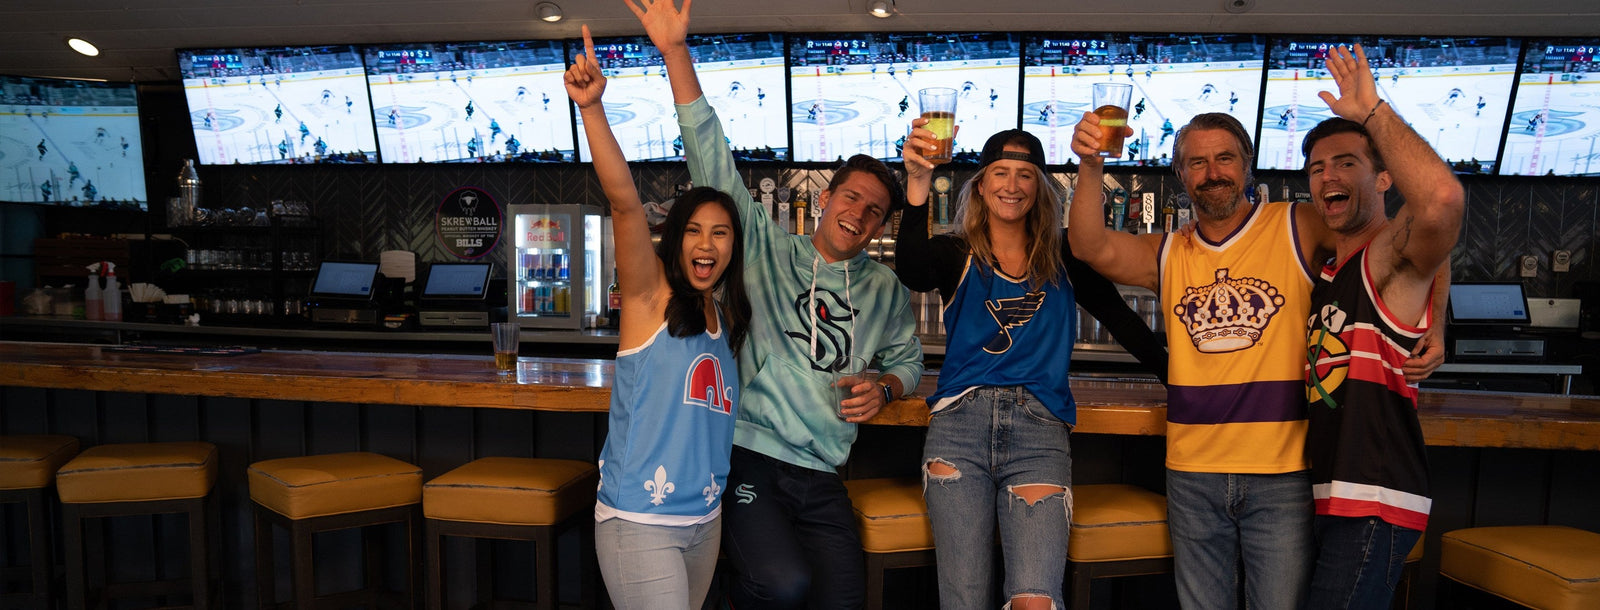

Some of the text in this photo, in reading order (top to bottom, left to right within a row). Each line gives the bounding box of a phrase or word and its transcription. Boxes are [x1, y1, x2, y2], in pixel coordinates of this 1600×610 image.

[441, 216, 497, 226] SKREWBALL
[526, 231, 564, 242] Red Bull
[456, 238, 483, 247] BILLS
